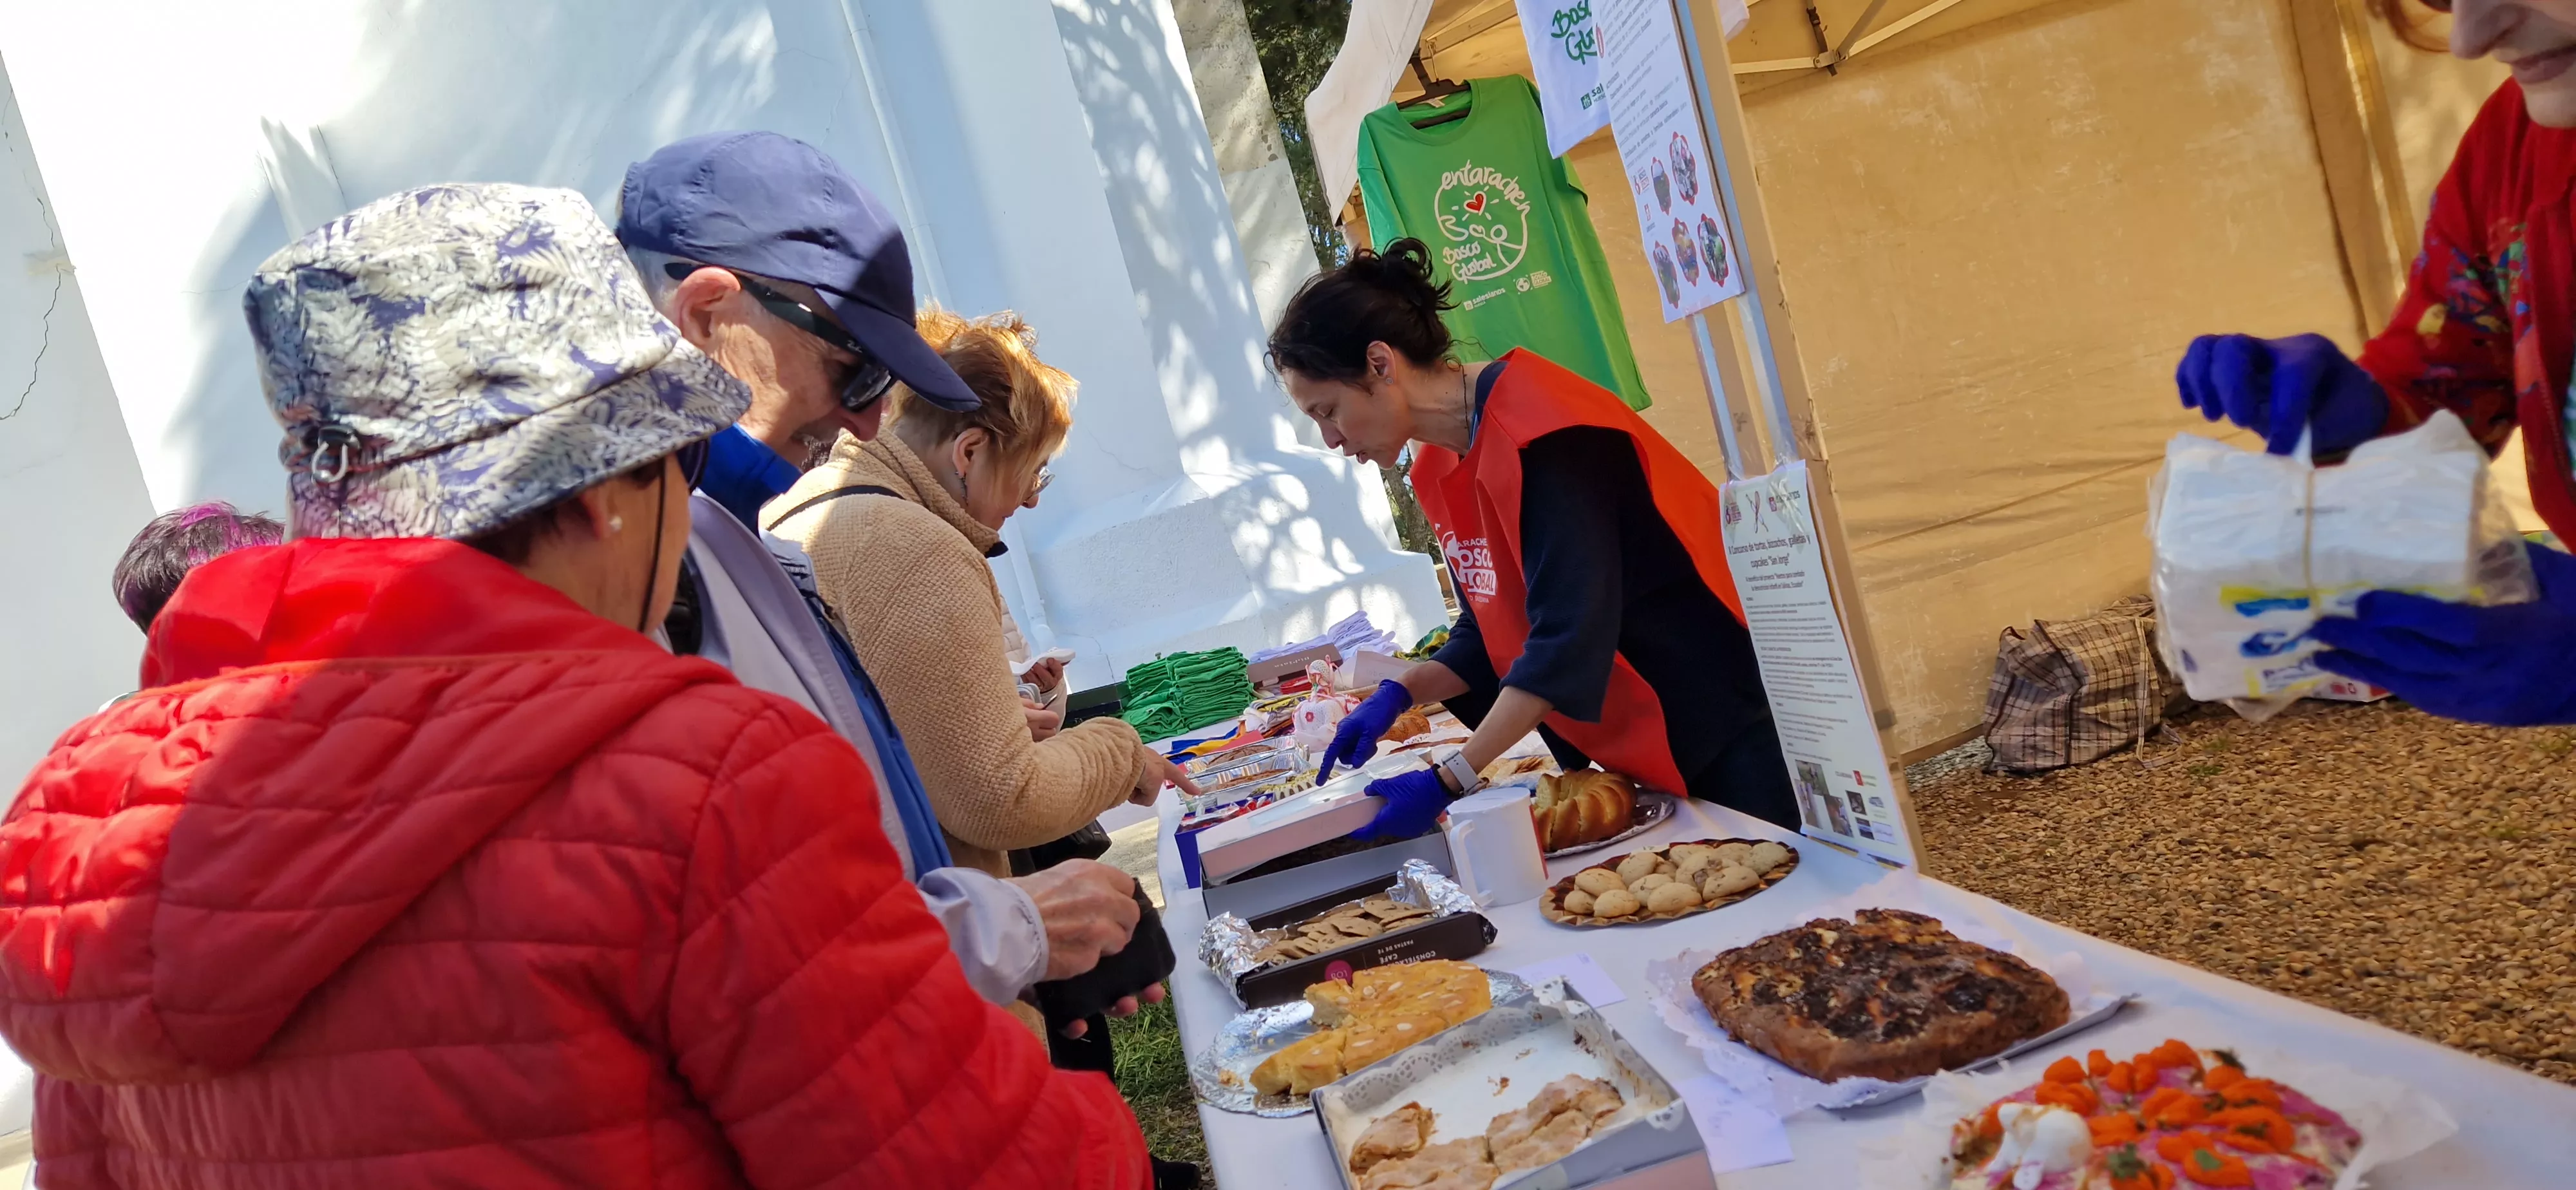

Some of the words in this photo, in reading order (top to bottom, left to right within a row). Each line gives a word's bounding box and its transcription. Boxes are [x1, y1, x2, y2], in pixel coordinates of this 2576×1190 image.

[1443, 241, 1481, 265] Bosco
[1451, 252, 1497, 285] Global
[1473, 288, 1506, 305] salesianos
[1465, 572, 1493, 591] LOBAL
[1394, 940, 1414, 949] PASTAS
